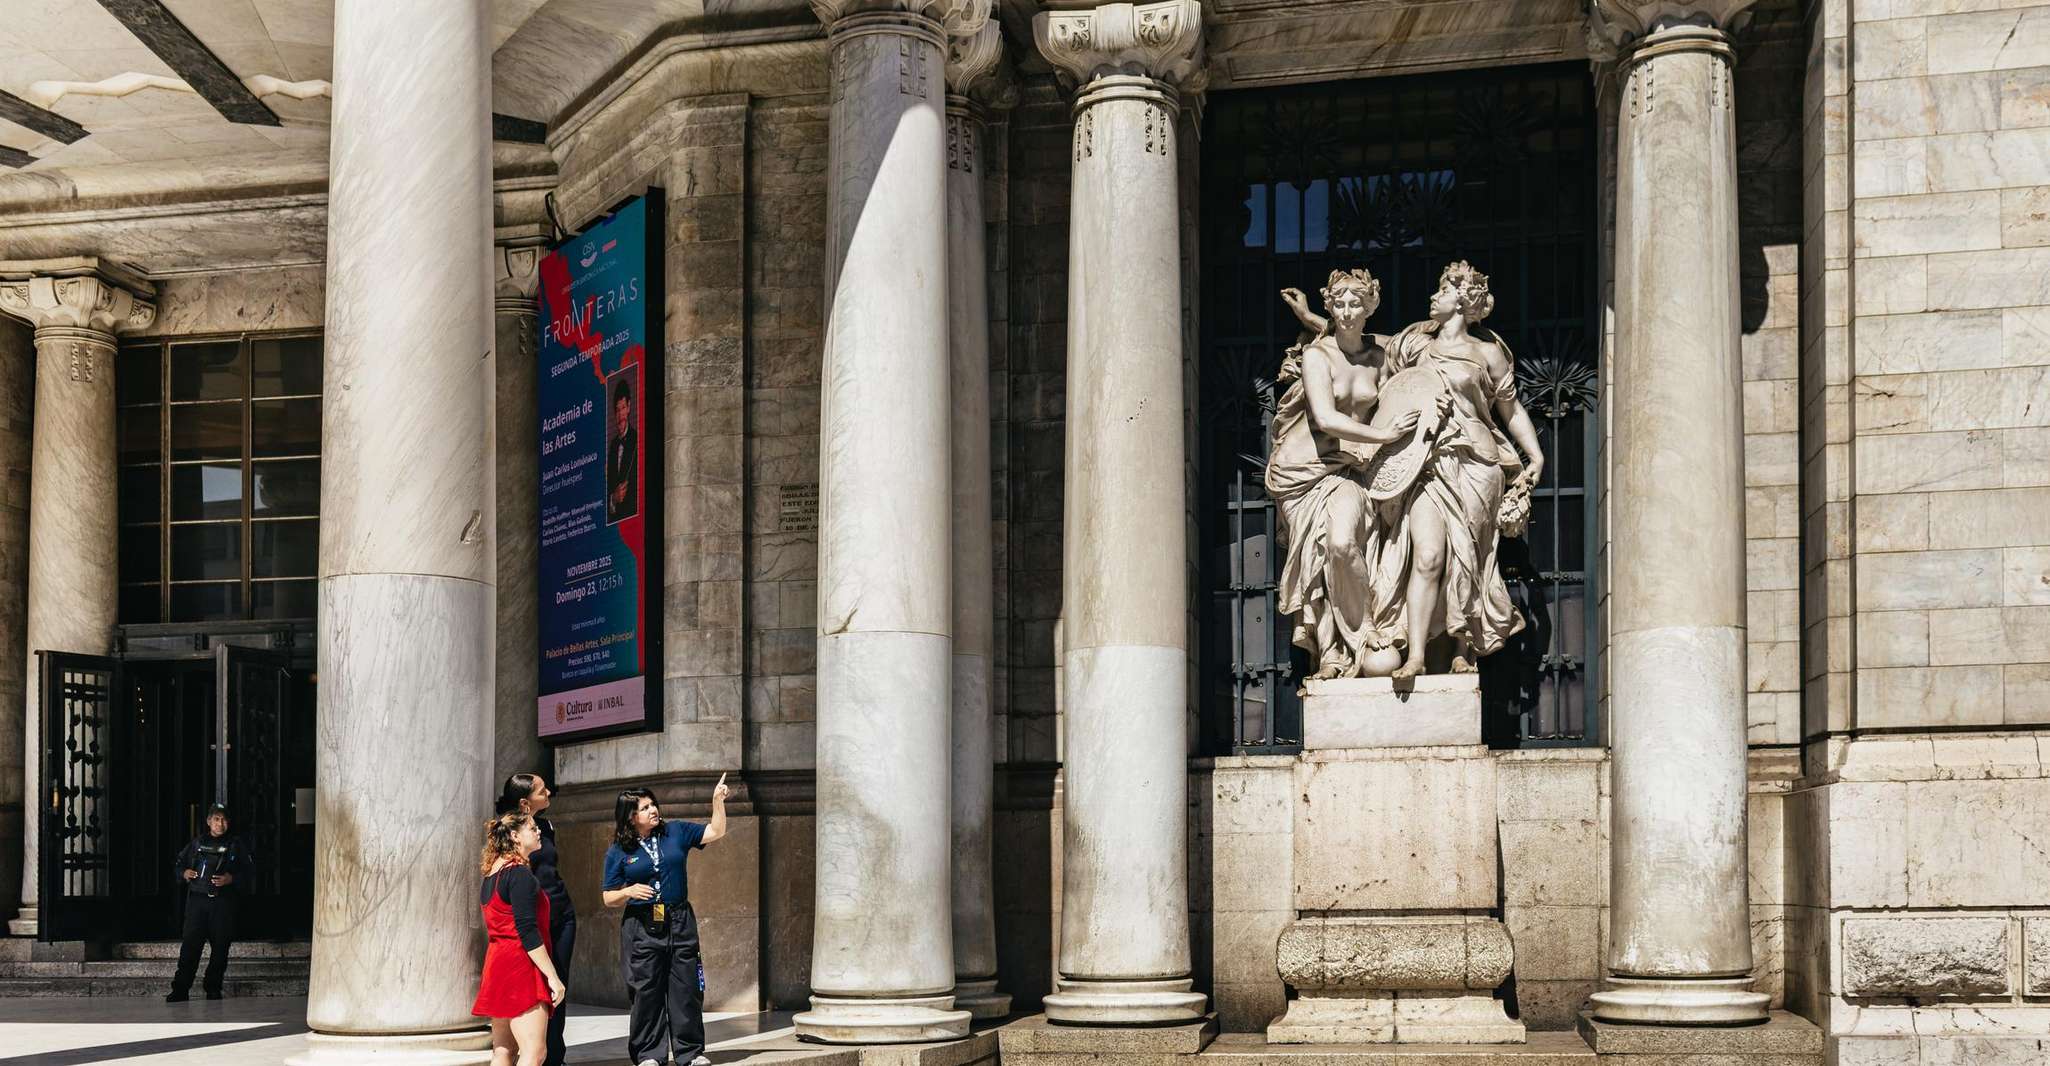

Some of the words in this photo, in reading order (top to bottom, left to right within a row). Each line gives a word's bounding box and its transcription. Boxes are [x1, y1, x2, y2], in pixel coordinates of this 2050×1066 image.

[544, 277, 639, 349] FRONTERAS
[551, 355, 578, 378] SEGUNDA
[578, 335, 615, 364] TEMPORADA
[615, 328, 630, 345] 2025
[543, 404, 581, 434] Academia
[582, 399, 593, 415] de
[542, 440, 554, 456] las
[554, 430, 577, 451] Artes
[542, 471, 554, 483] Juan
[554, 464, 570, 477] Carlos
[567, 560, 598, 577] NOVIEMBRE
[599, 554, 612, 568] 2025
[556, 587, 586, 604] Domingo
[587, 581, 597, 595] 23,
[599, 574, 617, 592] 12:15
[617, 572, 623, 586] h
[566, 700, 593, 715] Cultura
[603, 695, 624, 709] INBAL
